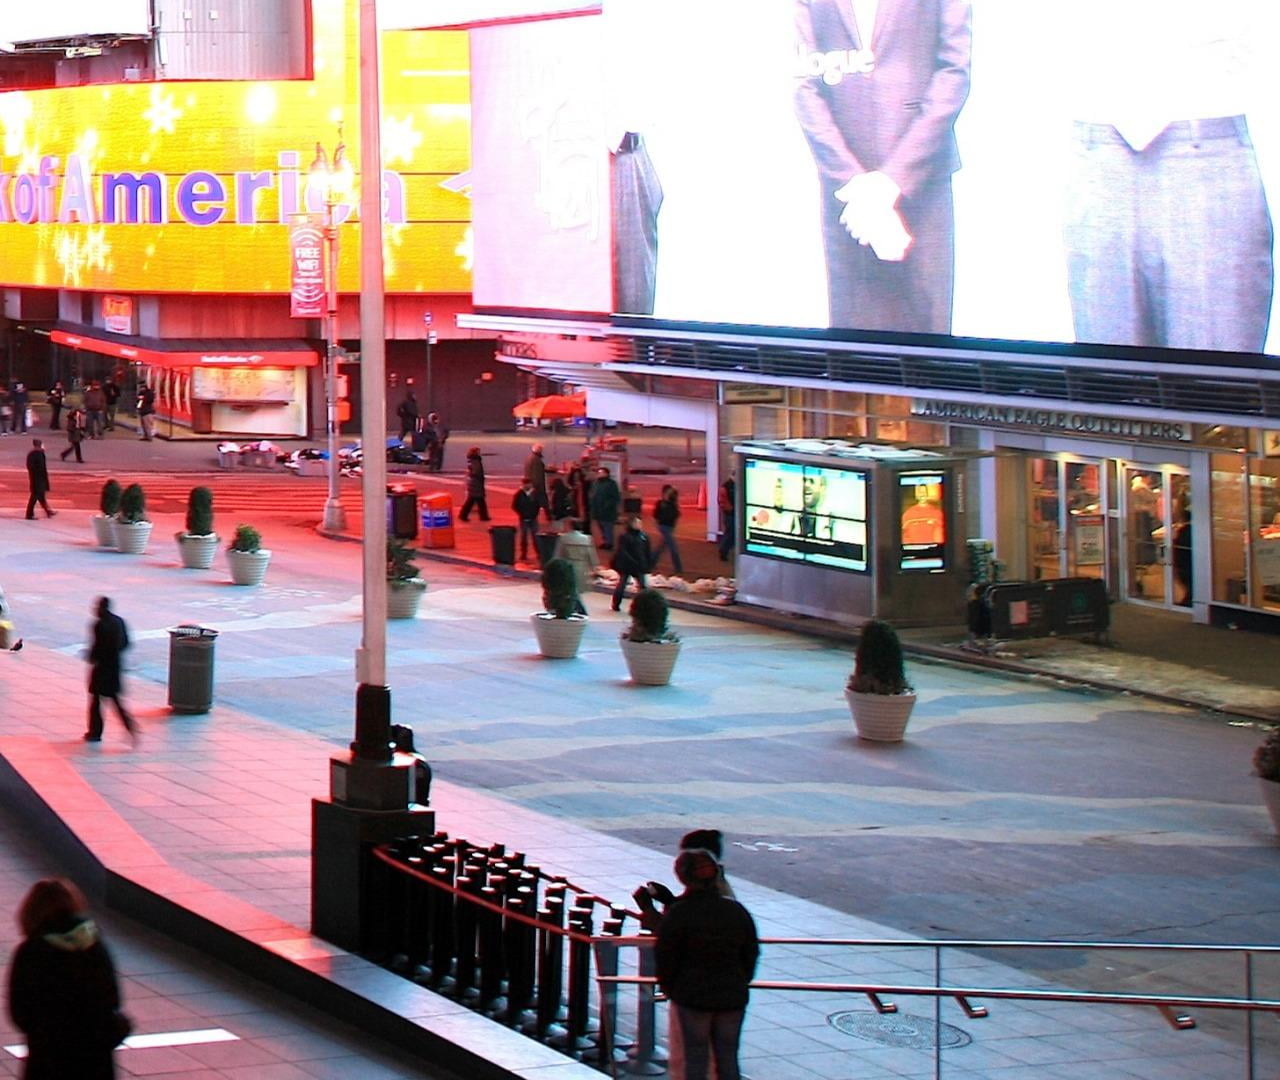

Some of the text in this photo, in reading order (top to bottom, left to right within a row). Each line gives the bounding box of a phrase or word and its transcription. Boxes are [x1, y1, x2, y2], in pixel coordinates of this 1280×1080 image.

[13, 155, 54, 223] of
[295, 248, 320, 259] FREE
[924, 400, 1185, 441] AMERICAN EAGLE OUTFITTERS
